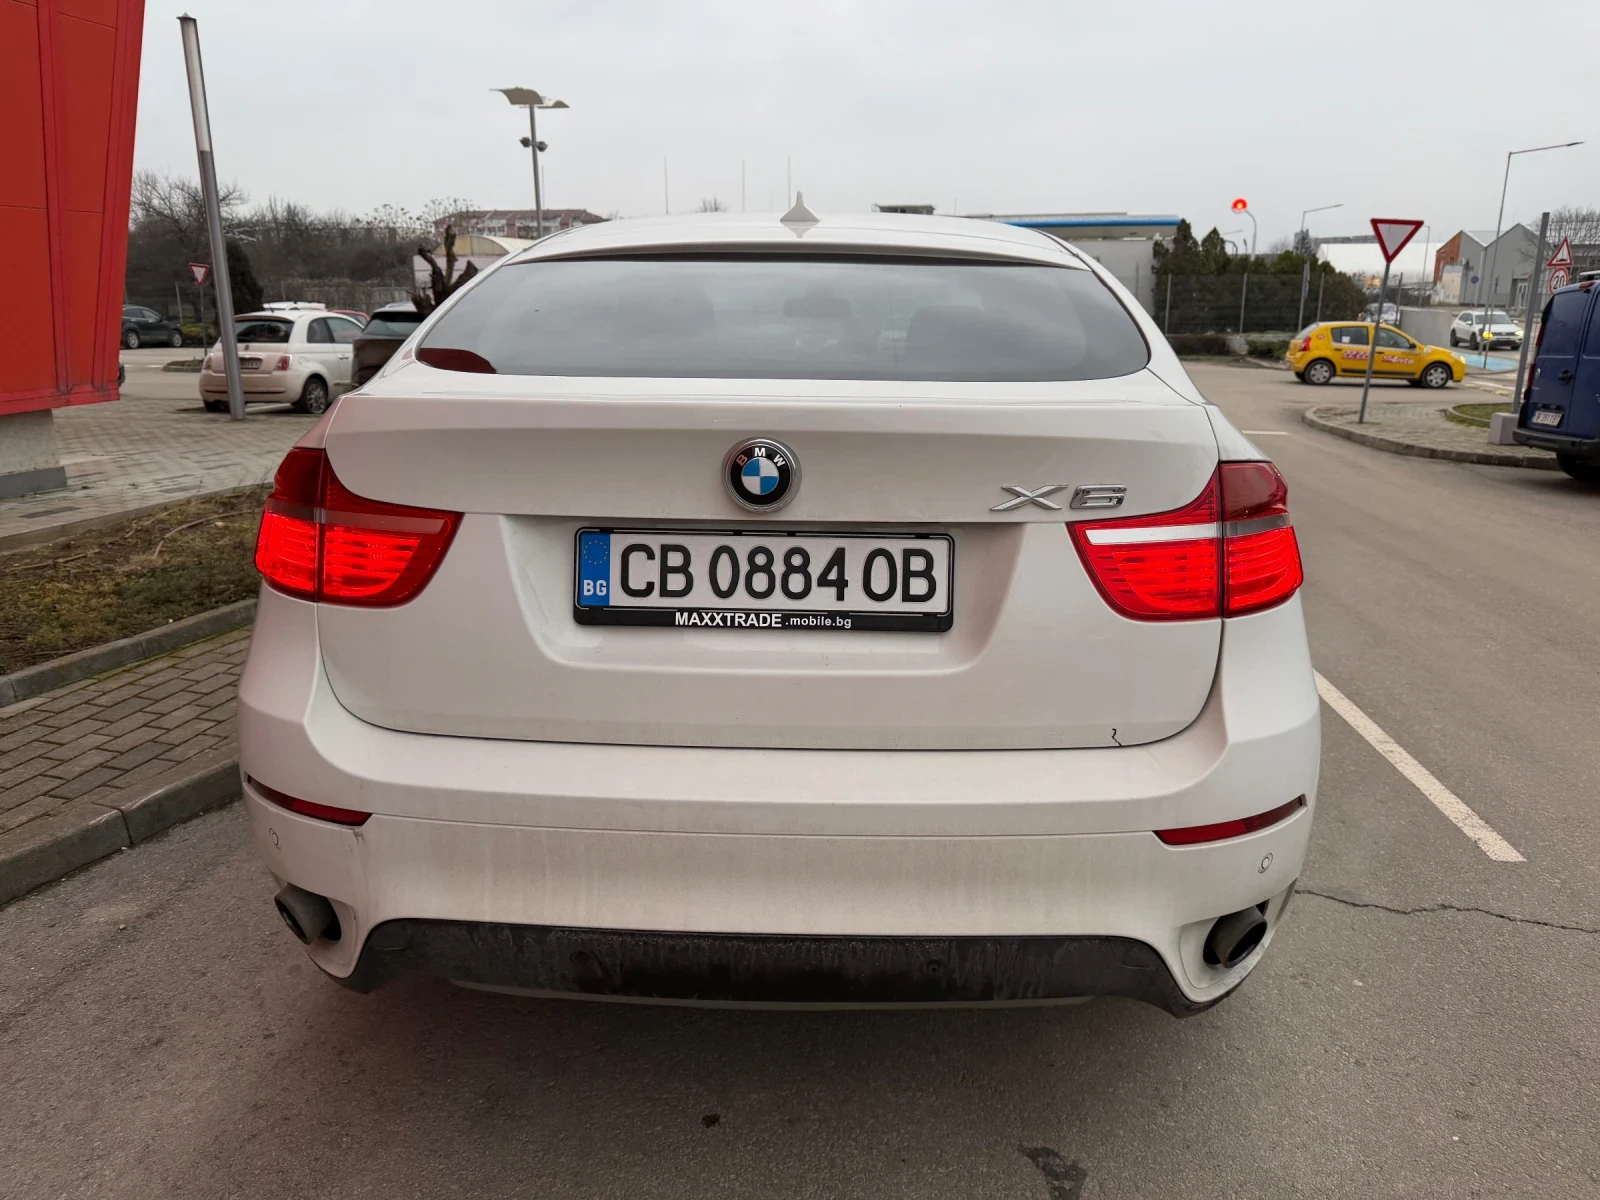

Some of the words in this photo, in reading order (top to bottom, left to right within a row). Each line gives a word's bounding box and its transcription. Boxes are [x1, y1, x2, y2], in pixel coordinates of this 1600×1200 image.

[1553, 275, 1565, 289] 20
[736, 447, 786, 467] BMW
[989, 484, 1127, 511] X6
[620, 543, 694, 598] CB
[708, 545, 849, 602] 0884
[862, 547, 937, 603] OB
[583, 579, 607, 596] BG
[675, 612, 782, 628] MAXXTRADE
